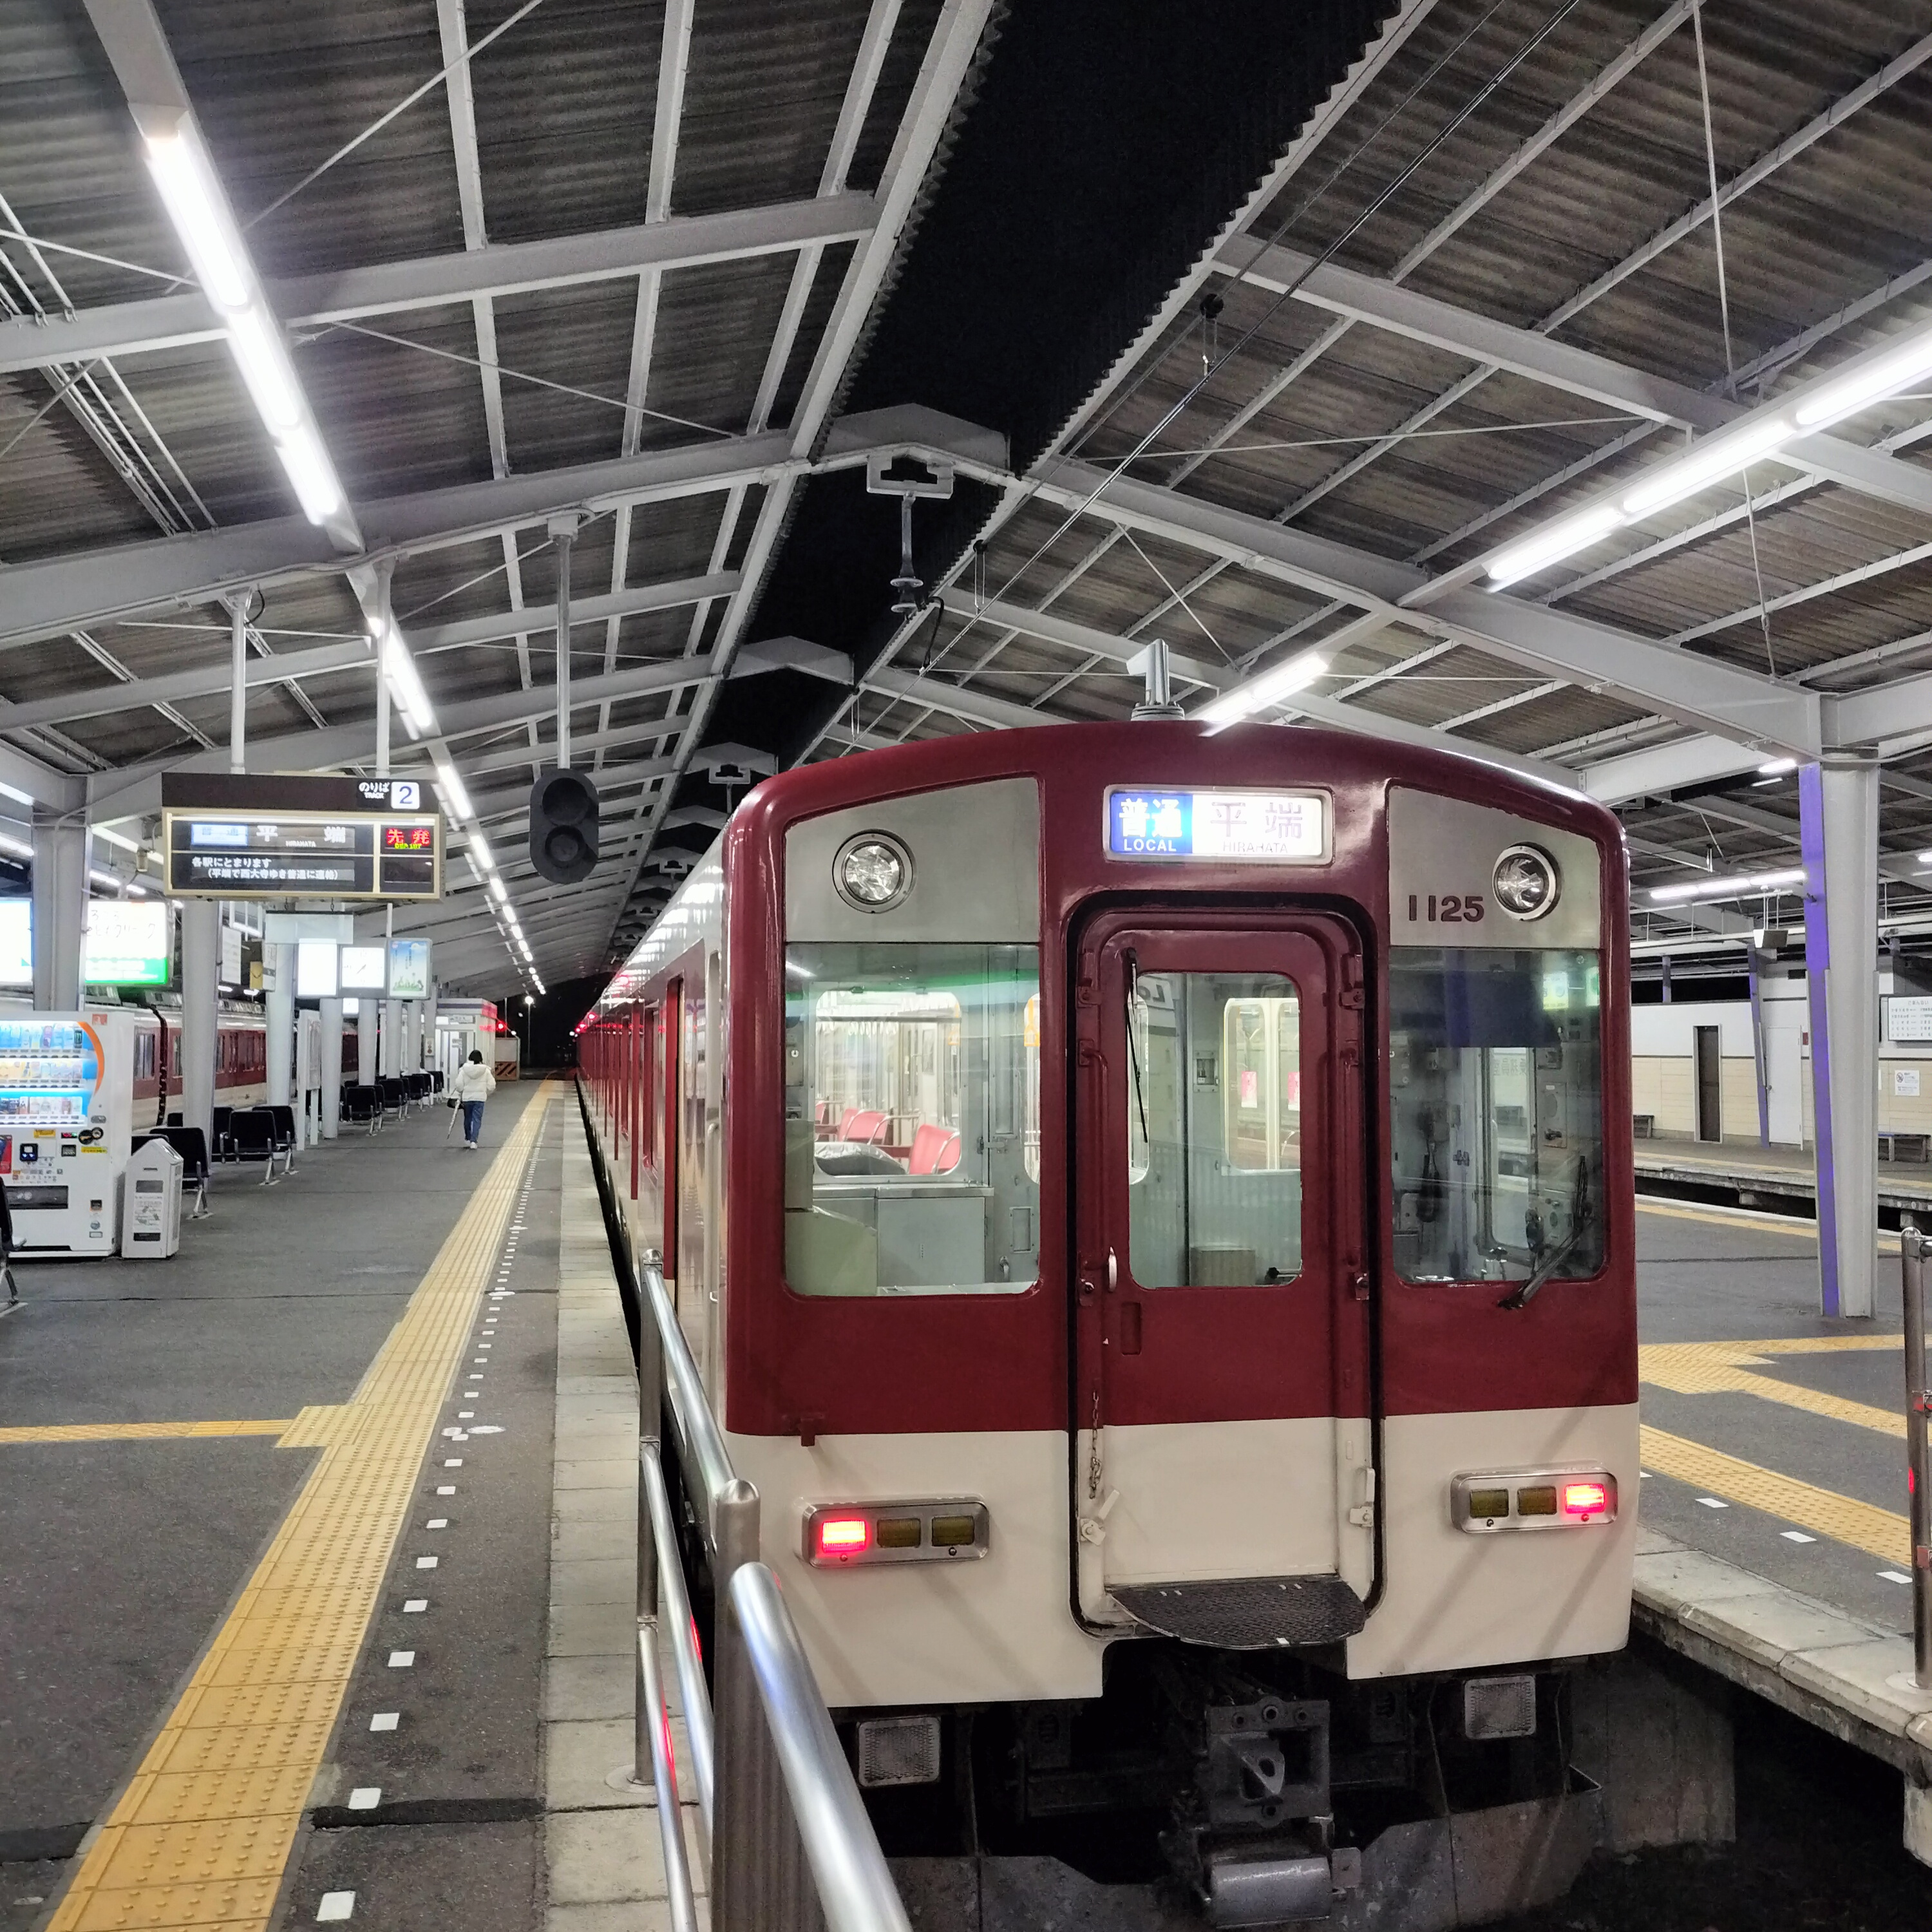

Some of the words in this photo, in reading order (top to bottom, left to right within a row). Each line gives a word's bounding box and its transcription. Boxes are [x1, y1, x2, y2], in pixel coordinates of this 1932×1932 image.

[359, 782, 390, 793] のりば
[399, 786, 413, 804] 2
[1119, 799, 1182, 837] 普通
[1210, 802, 1302, 838] 平端
[1124, 839, 1177, 852] LOCAL
[1223, 842, 1288, 853] HIRAHATA
[192, 856, 272, 868] 各駅にとまります
[1409, 895, 1484, 922] 1125
